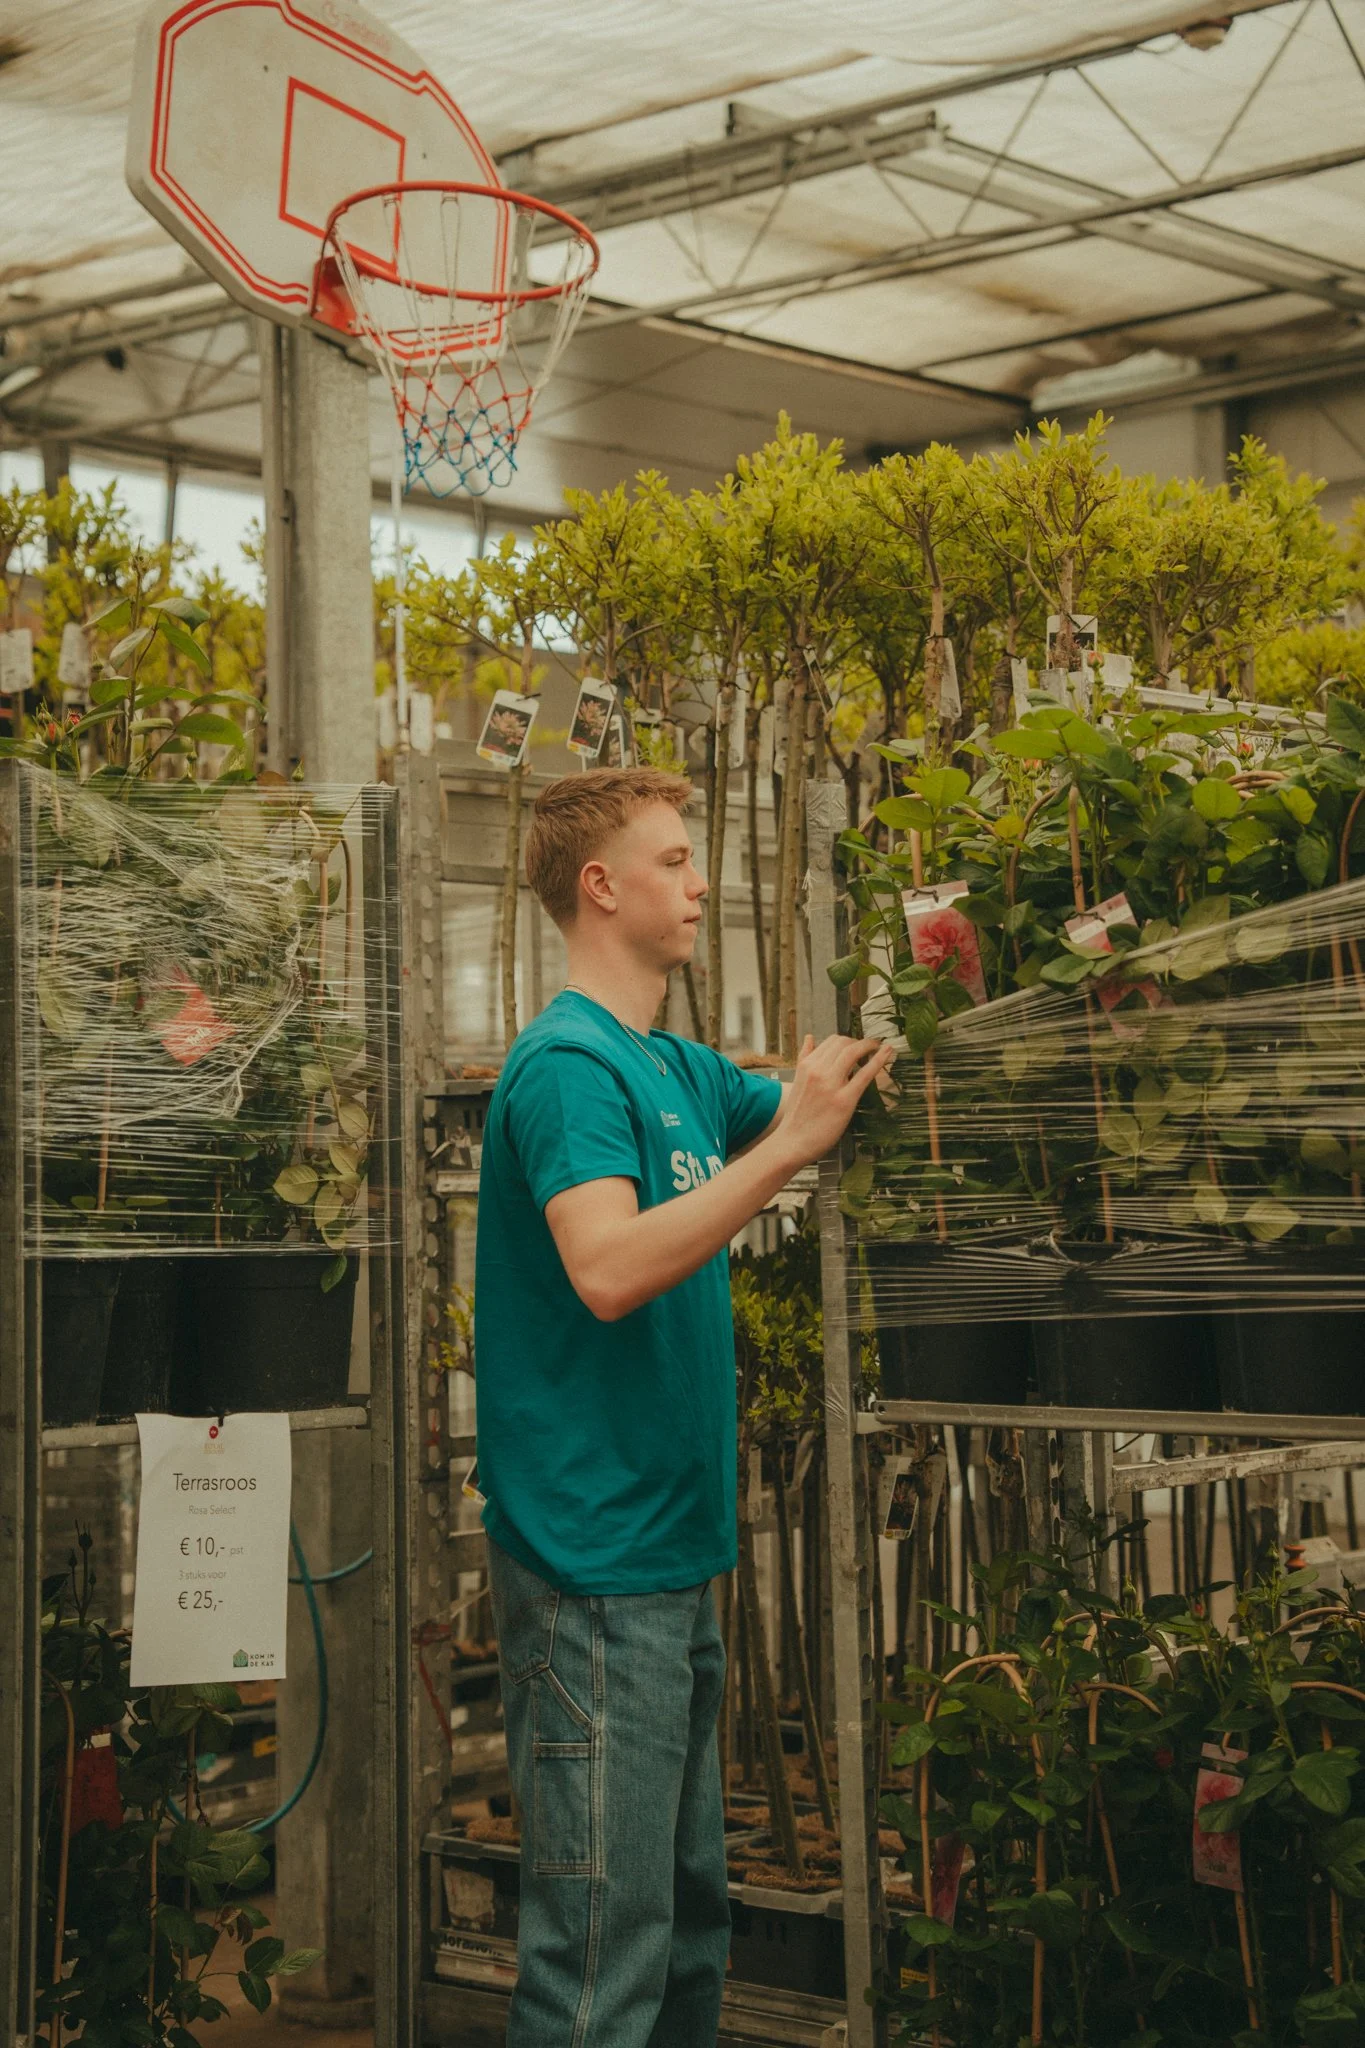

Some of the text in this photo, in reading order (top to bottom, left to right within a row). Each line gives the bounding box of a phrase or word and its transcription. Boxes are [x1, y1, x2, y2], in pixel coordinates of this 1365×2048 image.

[173, 1473, 257, 1492] Terrasroos
[188, 1504, 236, 1516] Rosa Select
[180, 1537, 190, 1557] €
[196, 1536, 226, 1558] 10,-
[178, 1569, 227, 1580] 3 stuks voor
[178, 1590, 224, 1612] € 25,-
